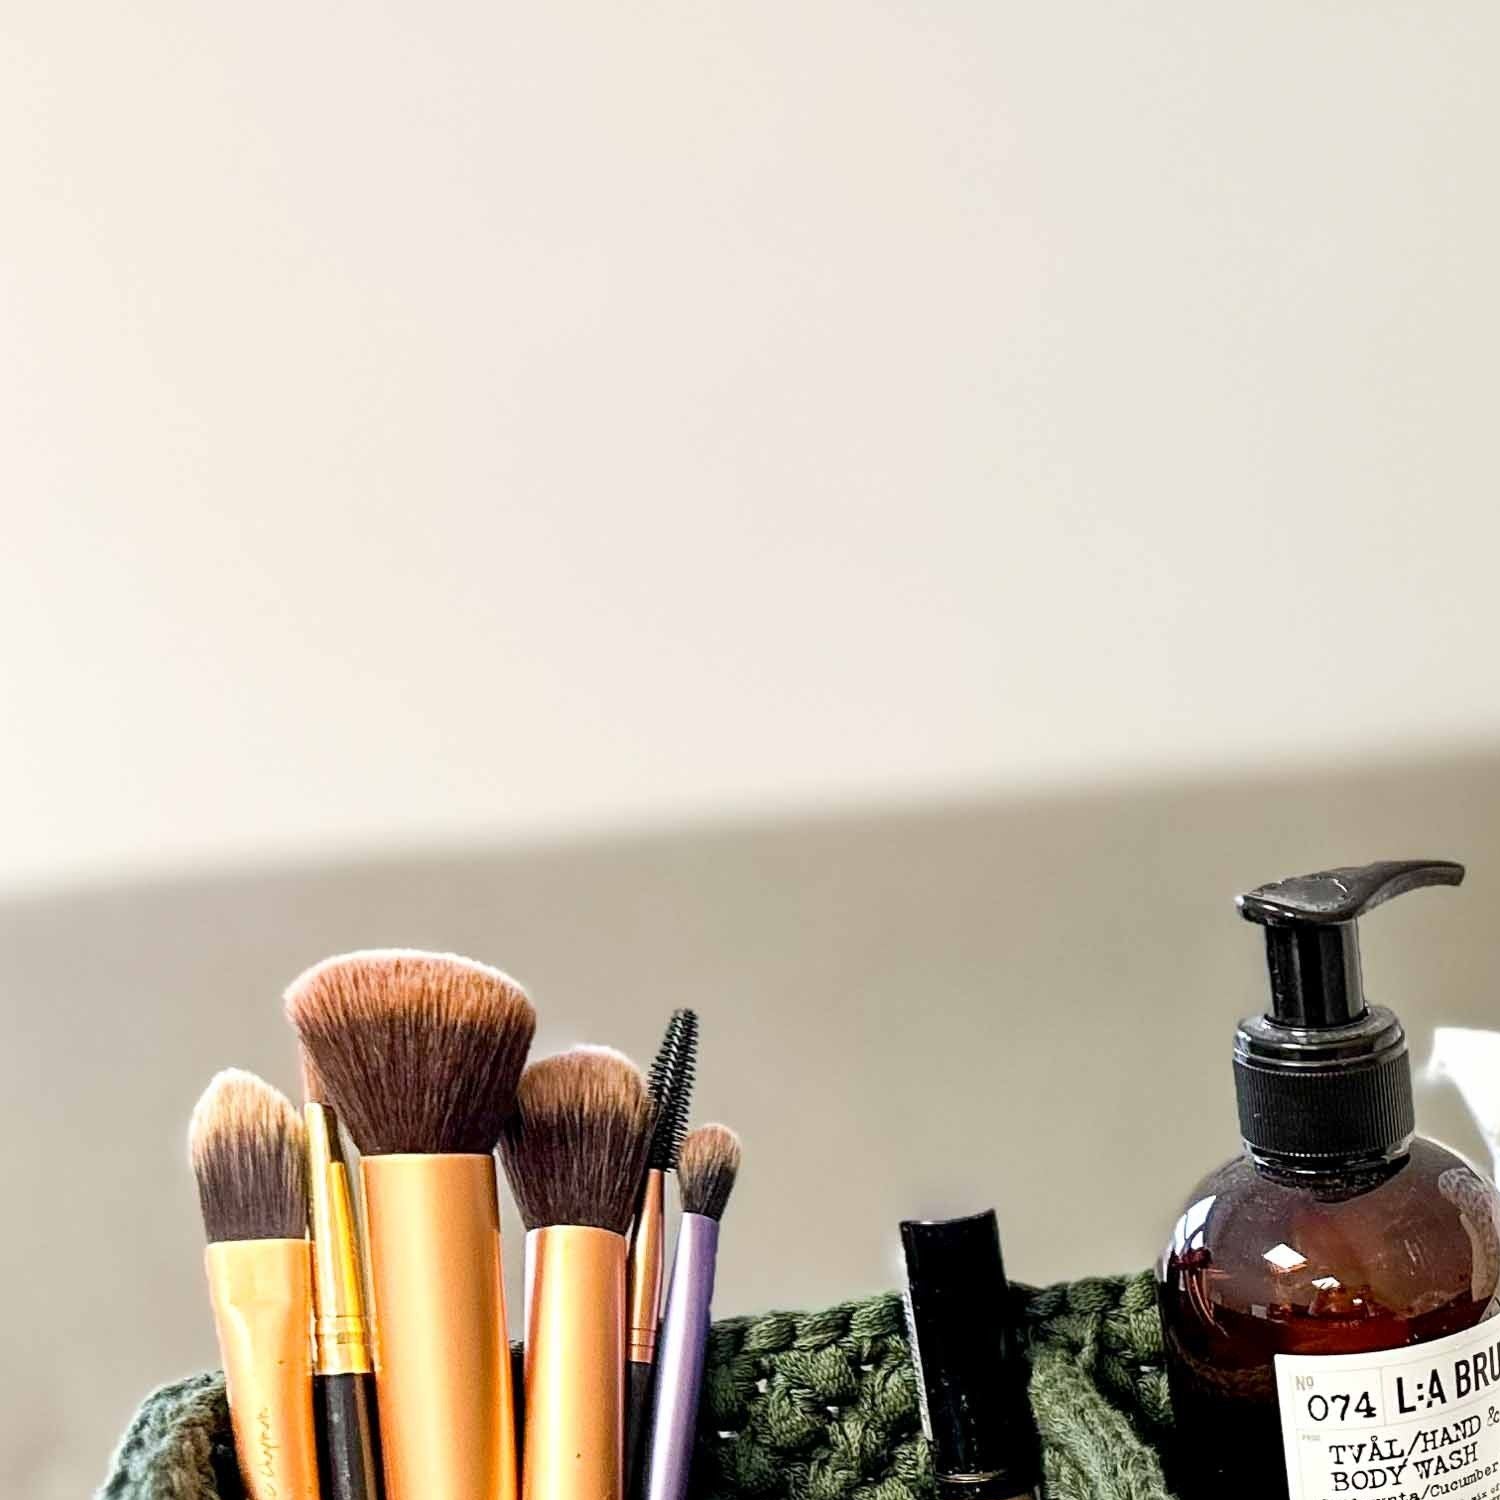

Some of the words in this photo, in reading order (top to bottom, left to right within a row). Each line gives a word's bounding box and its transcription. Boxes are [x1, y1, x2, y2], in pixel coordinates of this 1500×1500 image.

[1308, 1392, 1377, 1421] 074
[1396, 1369, 1446, 1414] L:A
[1329, 1415, 1481, 1465] TVÅL/HAND
[1331, 1458, 1408, 1491] BODY
[1413, 1441, 1478, 1479] WASH
[1490, 1483, 1500, 1493] of
